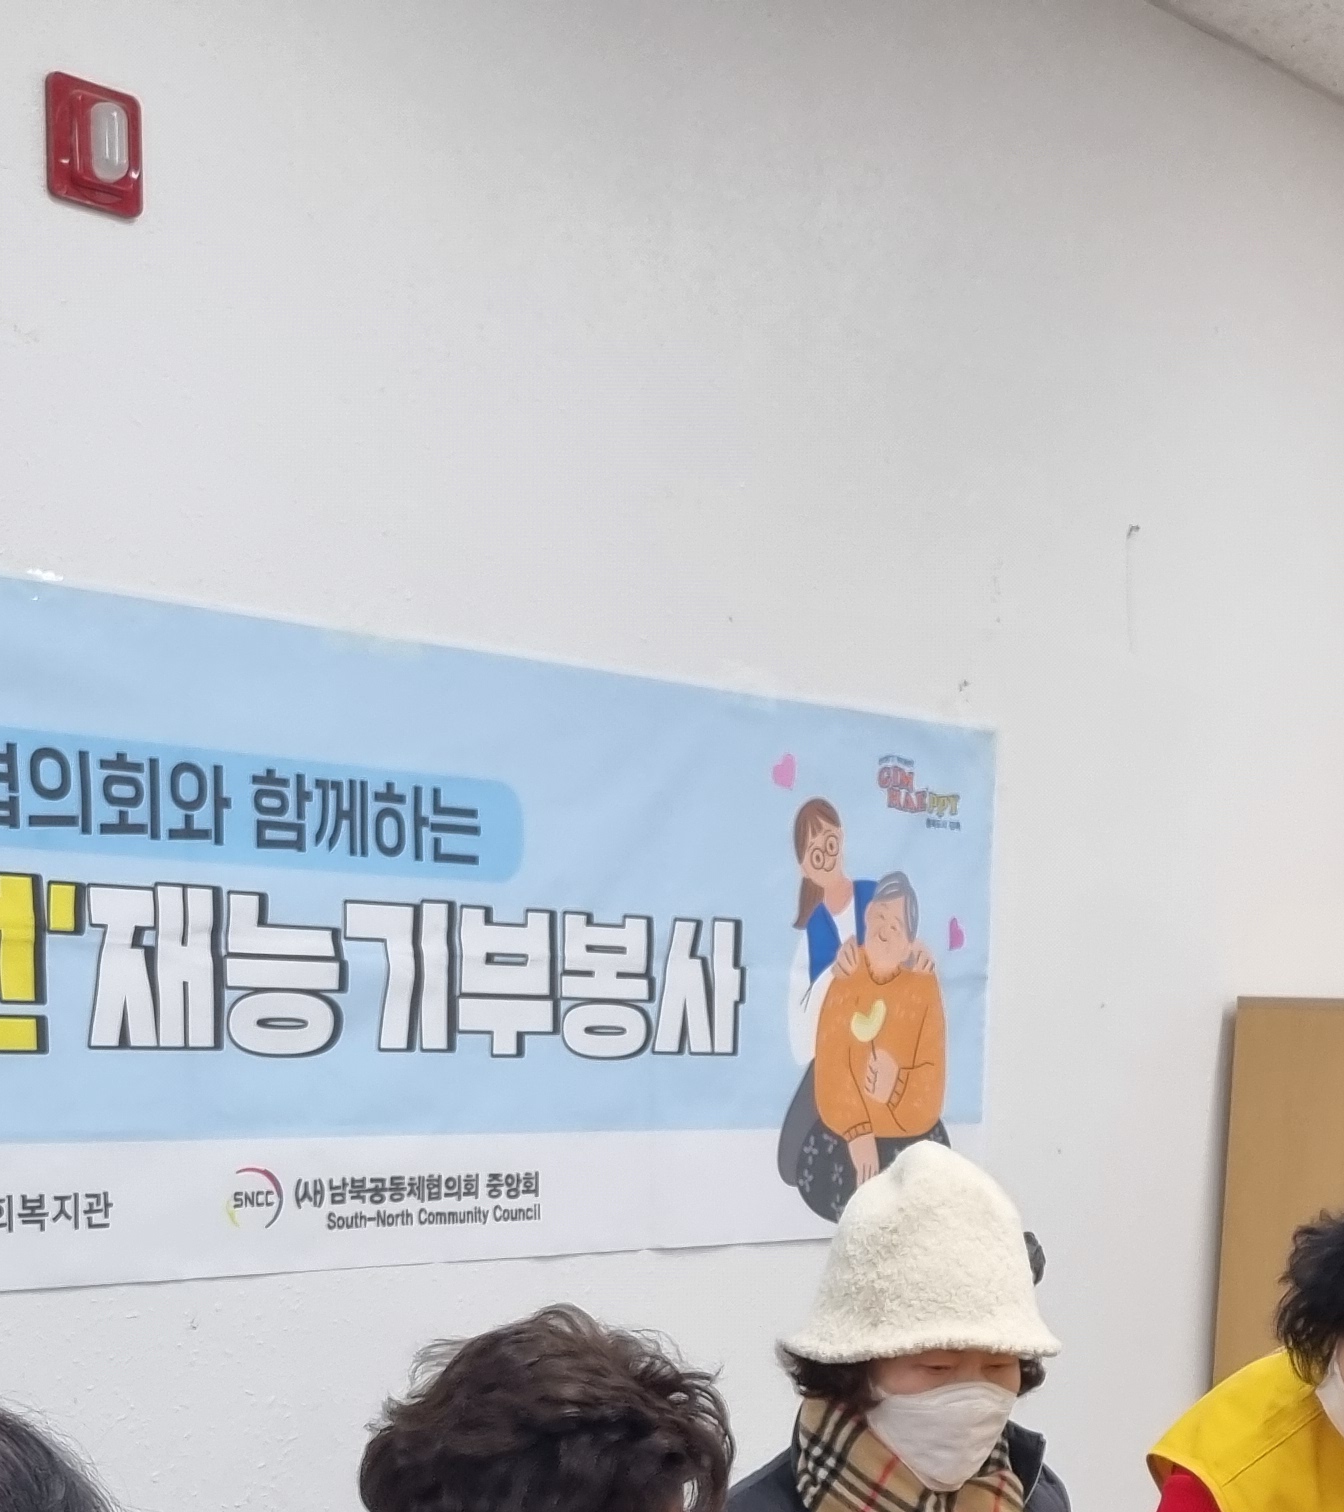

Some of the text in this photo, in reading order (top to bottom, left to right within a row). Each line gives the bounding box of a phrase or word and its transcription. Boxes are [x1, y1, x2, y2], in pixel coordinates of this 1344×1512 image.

[250, 768, 480, 866] 함께하는
[485, 1170, 540, 1199] 중앙회
[233, 1189, 275, 1209] SNCC
[327, 1204, 541, 1230] South-North Community Council
